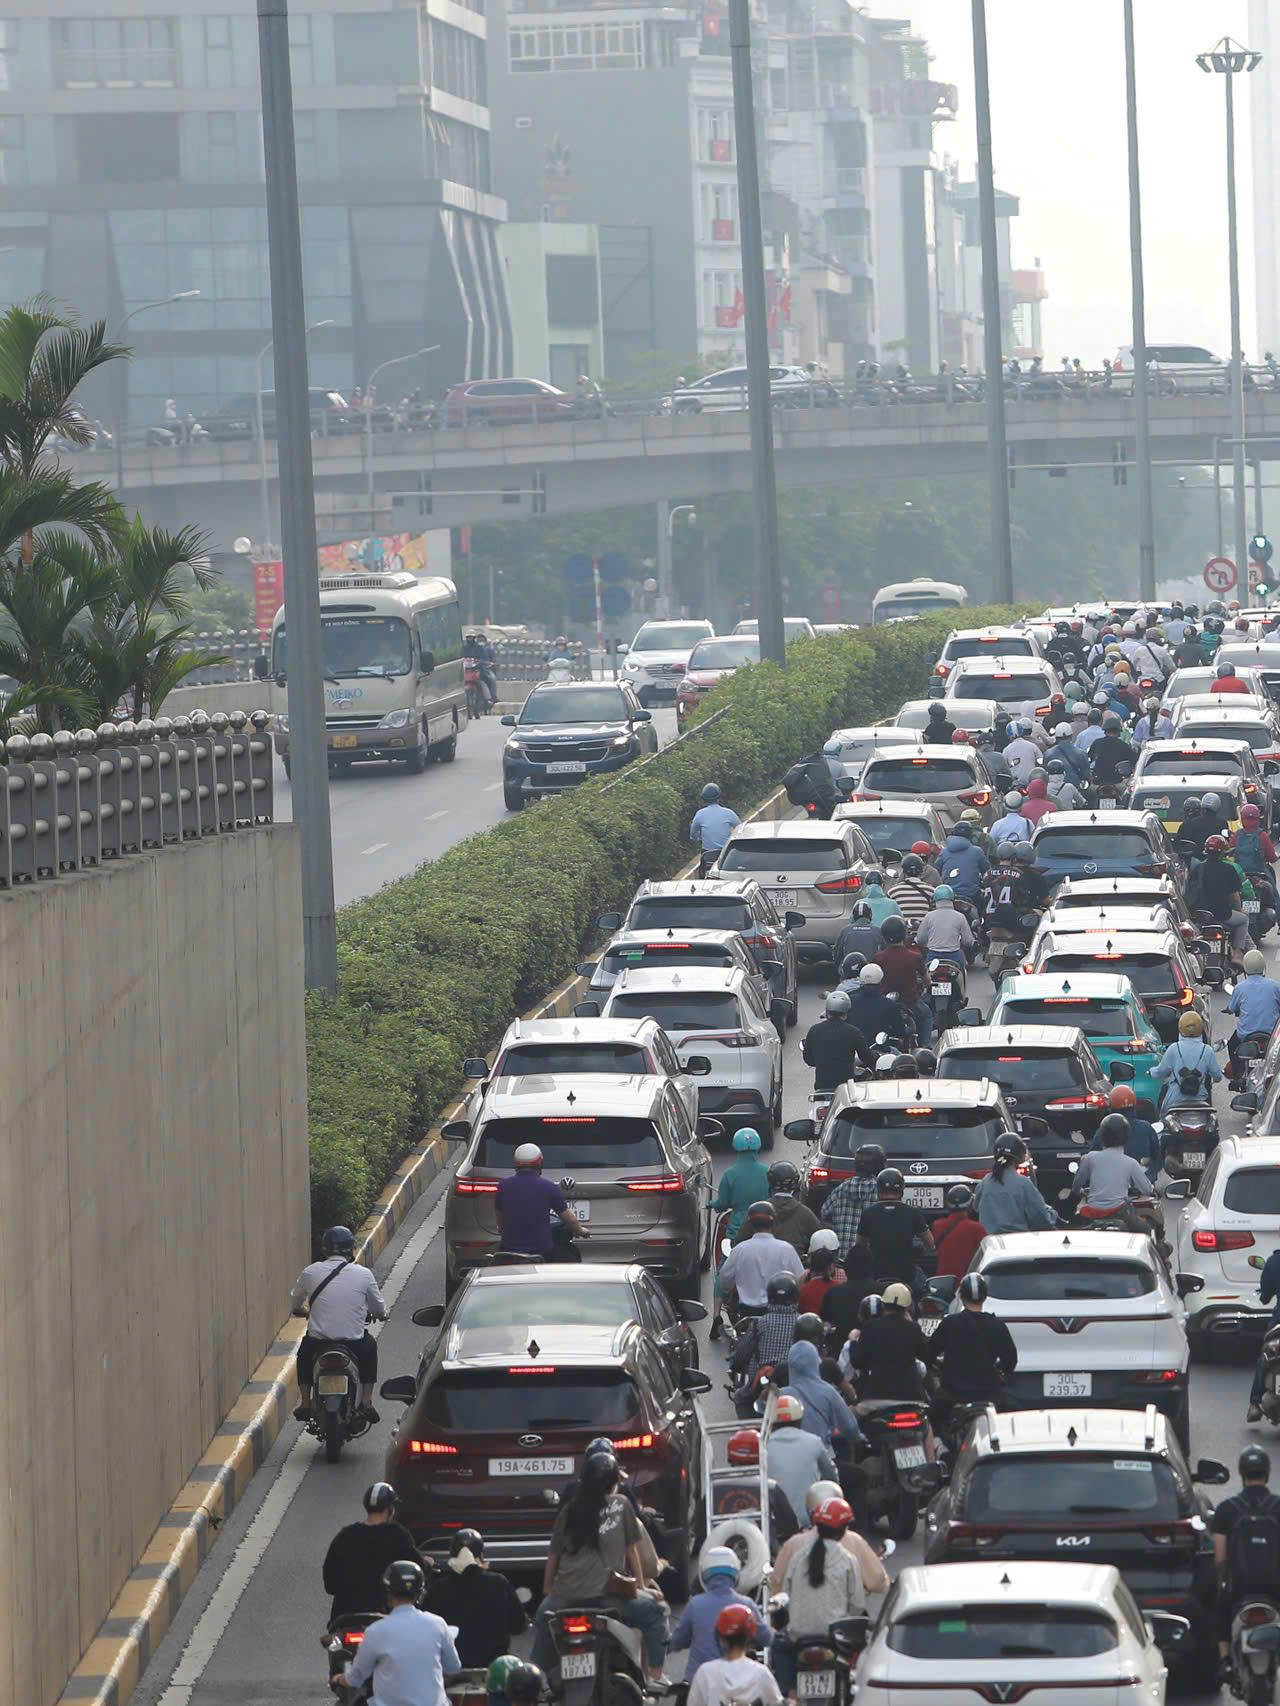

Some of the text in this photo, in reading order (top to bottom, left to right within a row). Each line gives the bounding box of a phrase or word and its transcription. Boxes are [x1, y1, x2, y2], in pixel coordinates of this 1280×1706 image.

[913, 1188, 932, 1197] 30G
[1057, 1374, 1078, 1385] 30L
[1049, 1384, 1087, 1396] 239.37
[1056, 1536, 1090, 1546] KIA
